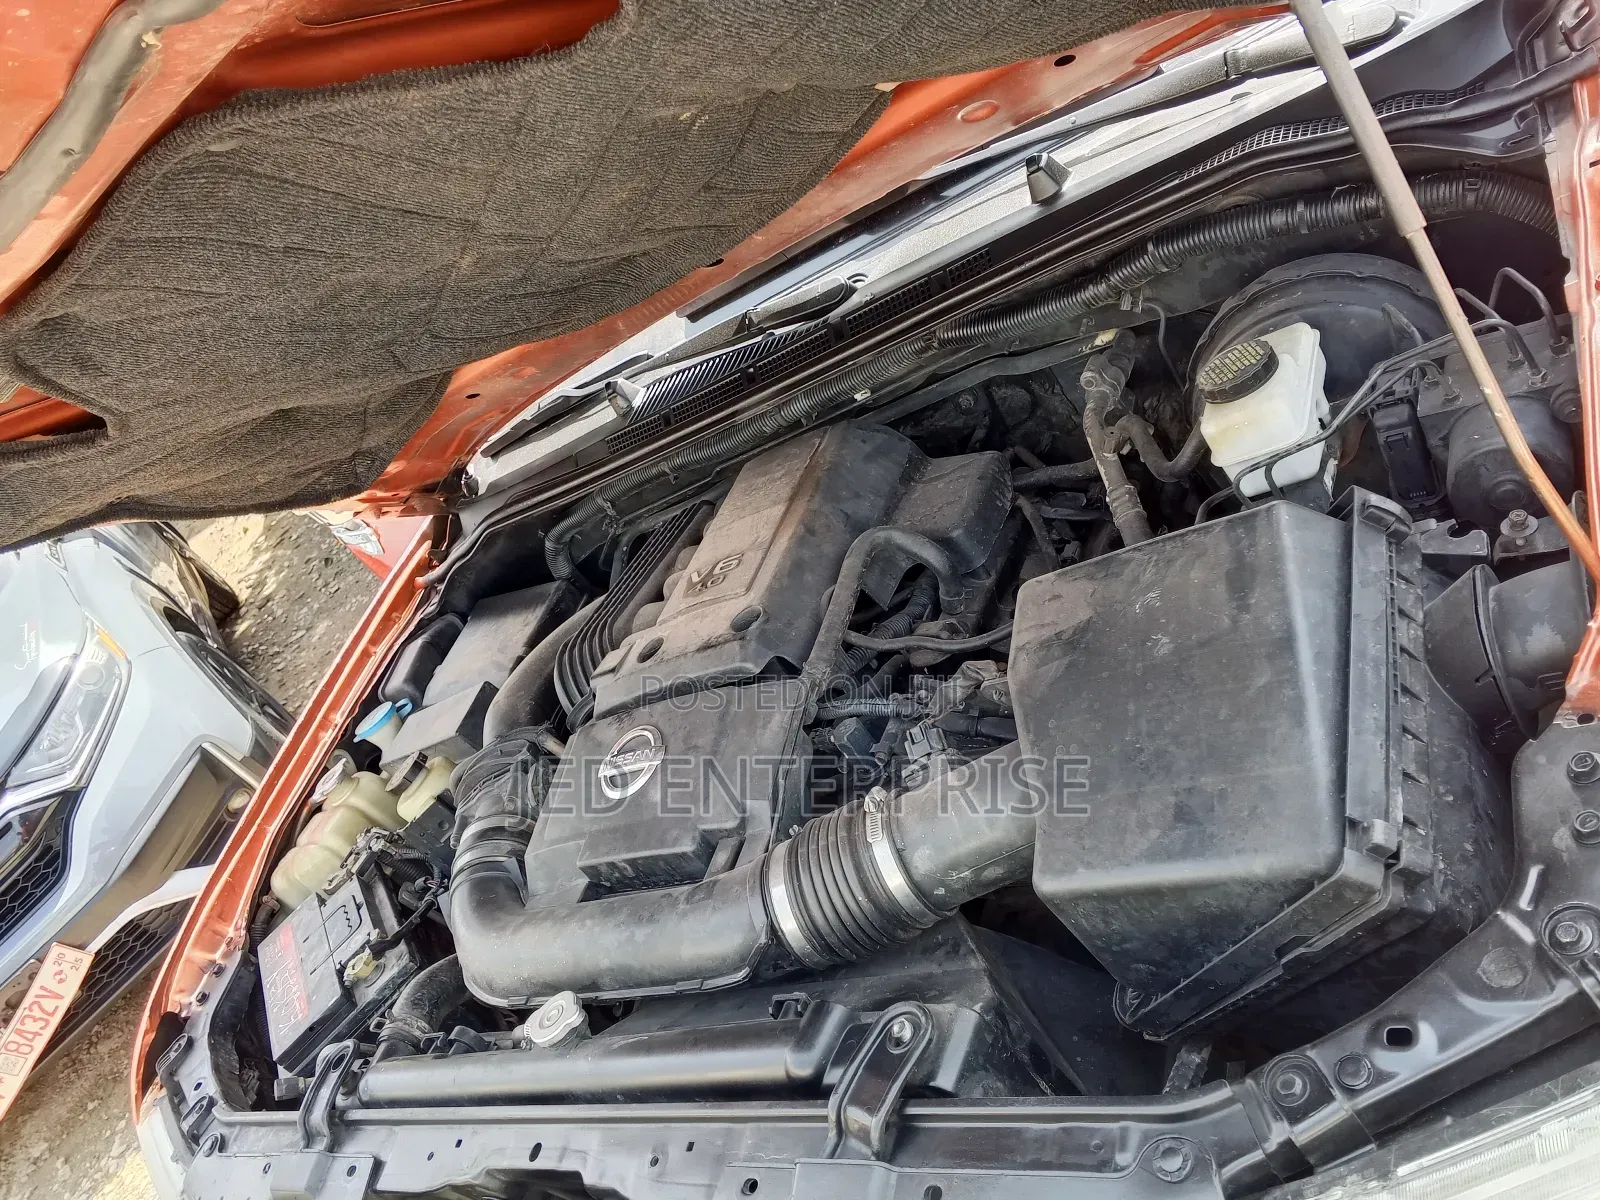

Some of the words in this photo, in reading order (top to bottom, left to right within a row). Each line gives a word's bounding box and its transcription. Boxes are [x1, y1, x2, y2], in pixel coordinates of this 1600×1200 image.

[690, 553, 744, 584] V6
[601, 747, 656, 772] NISSAN
[4, 985, 65, 1056] 8432V
